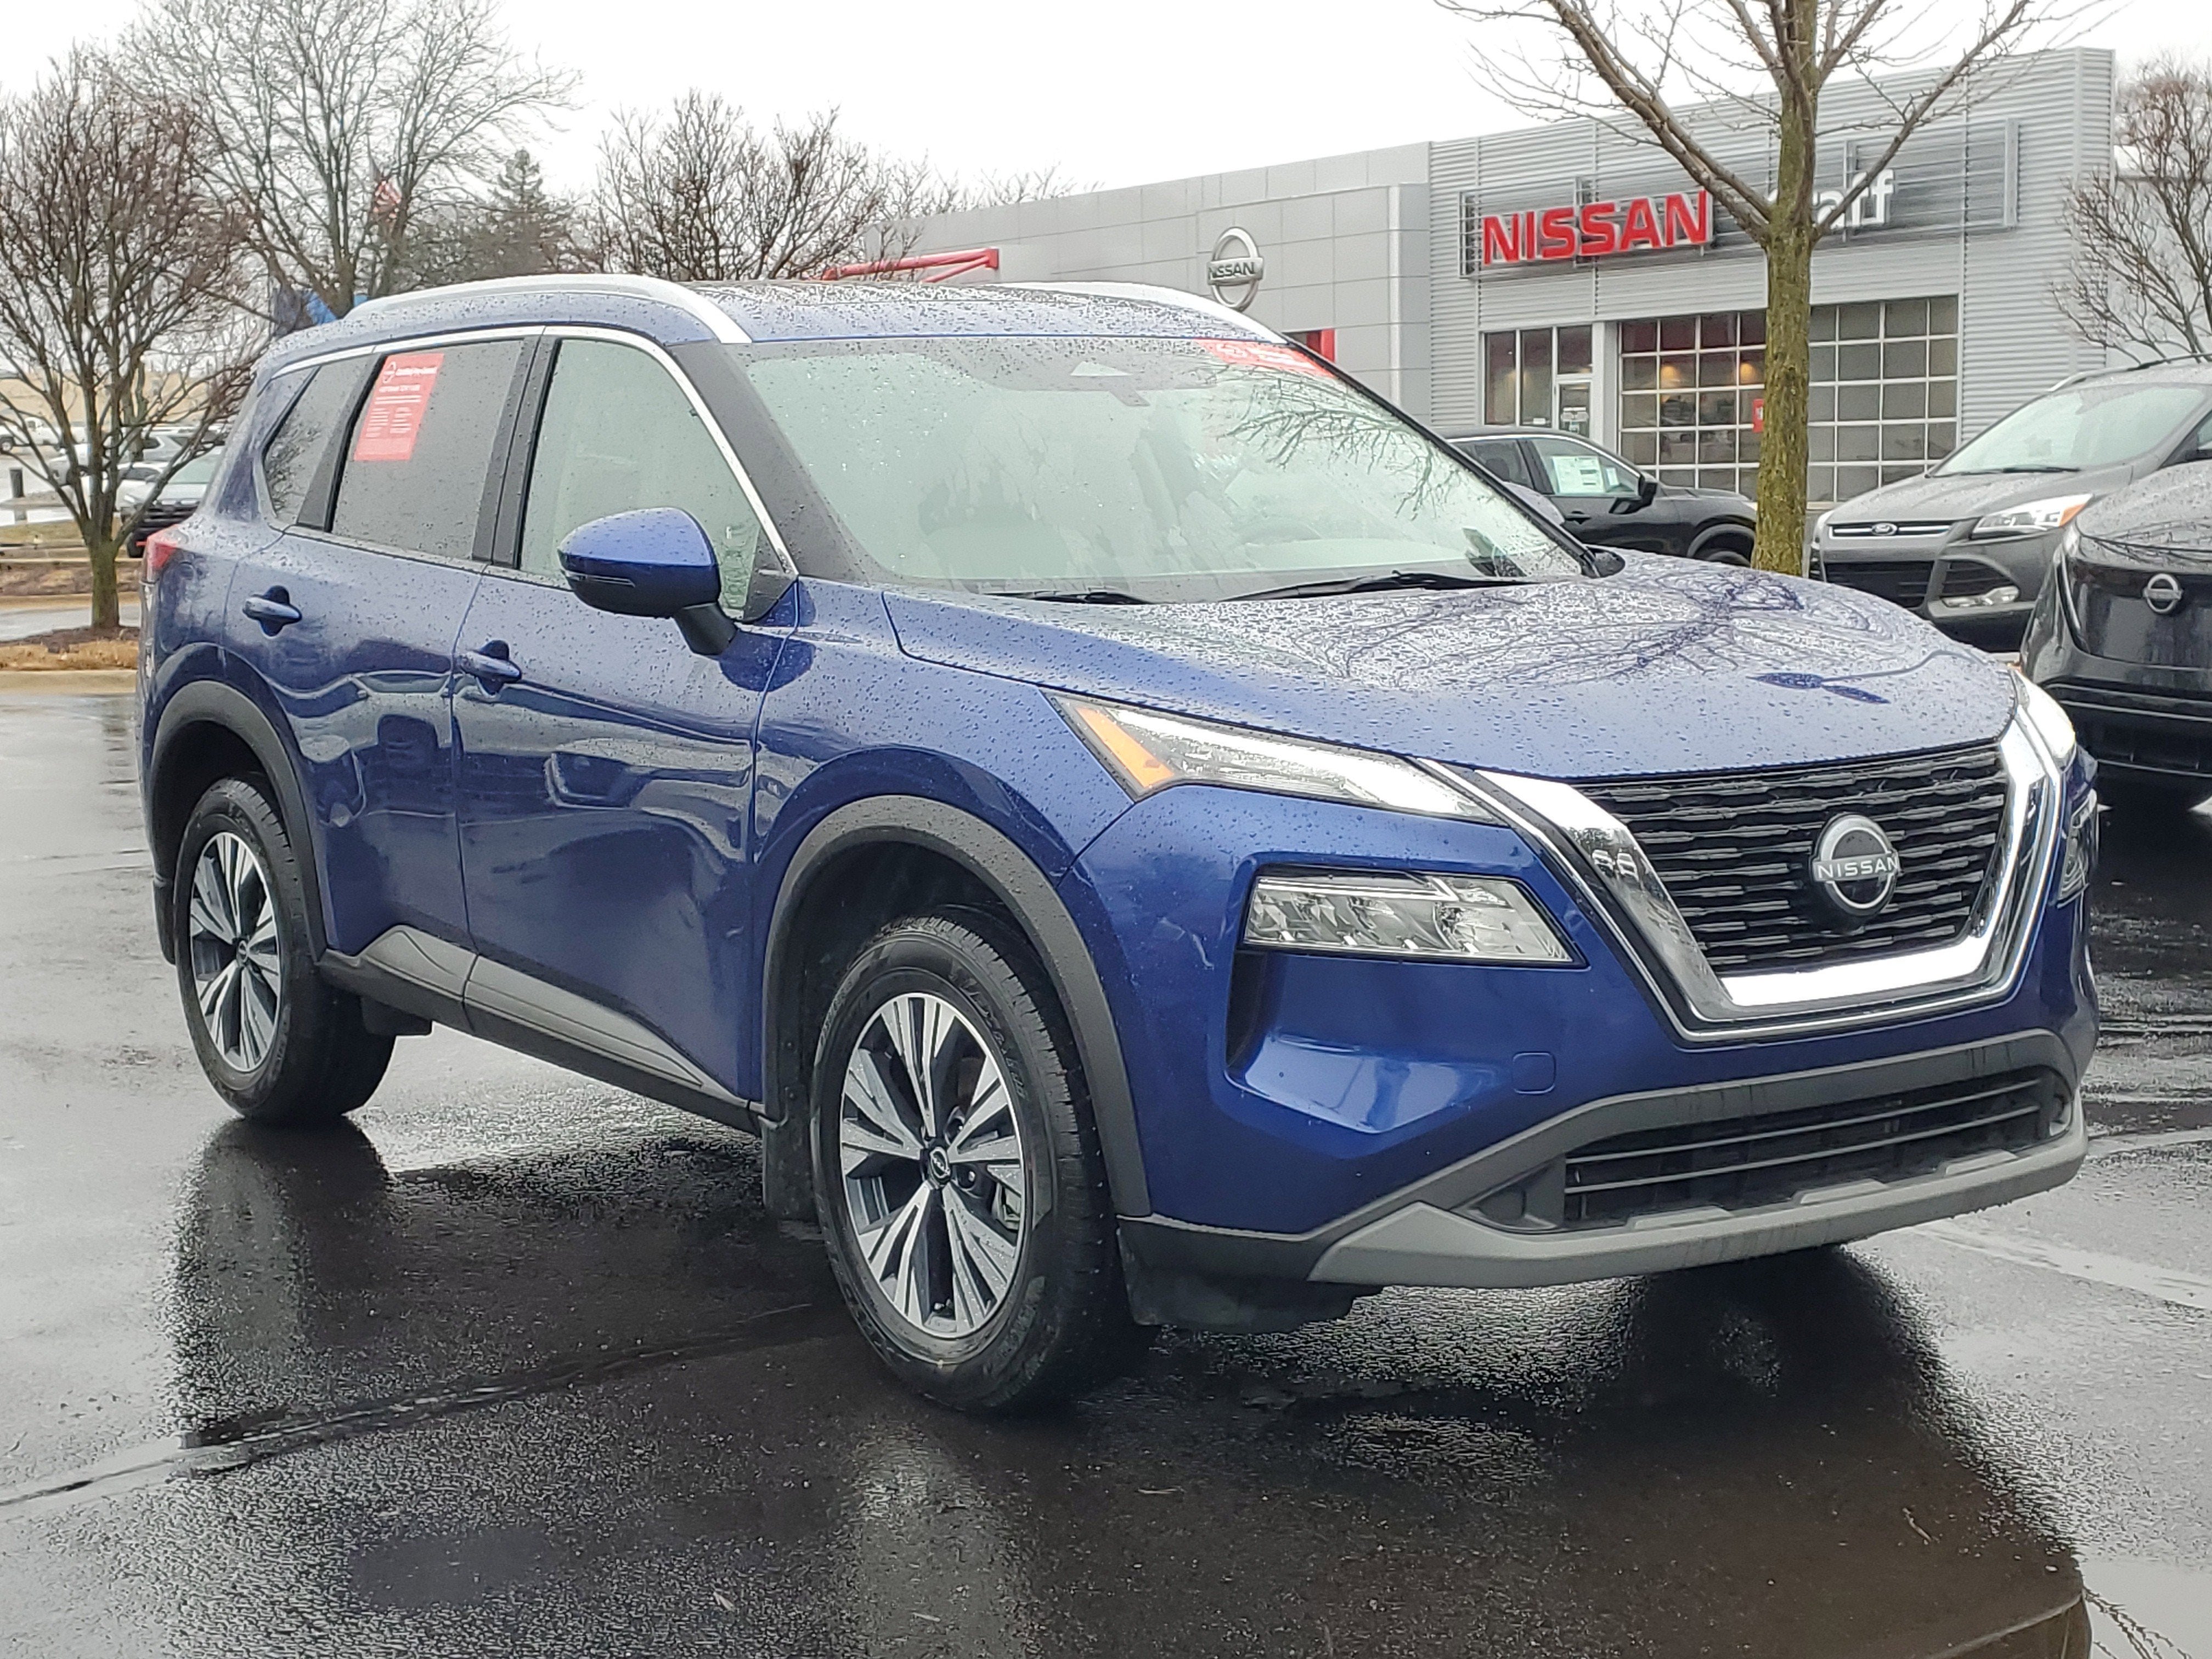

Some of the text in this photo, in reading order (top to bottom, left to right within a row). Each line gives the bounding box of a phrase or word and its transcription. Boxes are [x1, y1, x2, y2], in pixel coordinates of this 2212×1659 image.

[1482, 168, 1894, 266] NISSAN aff
[1817, 857, 1898, 878] NISSAN
